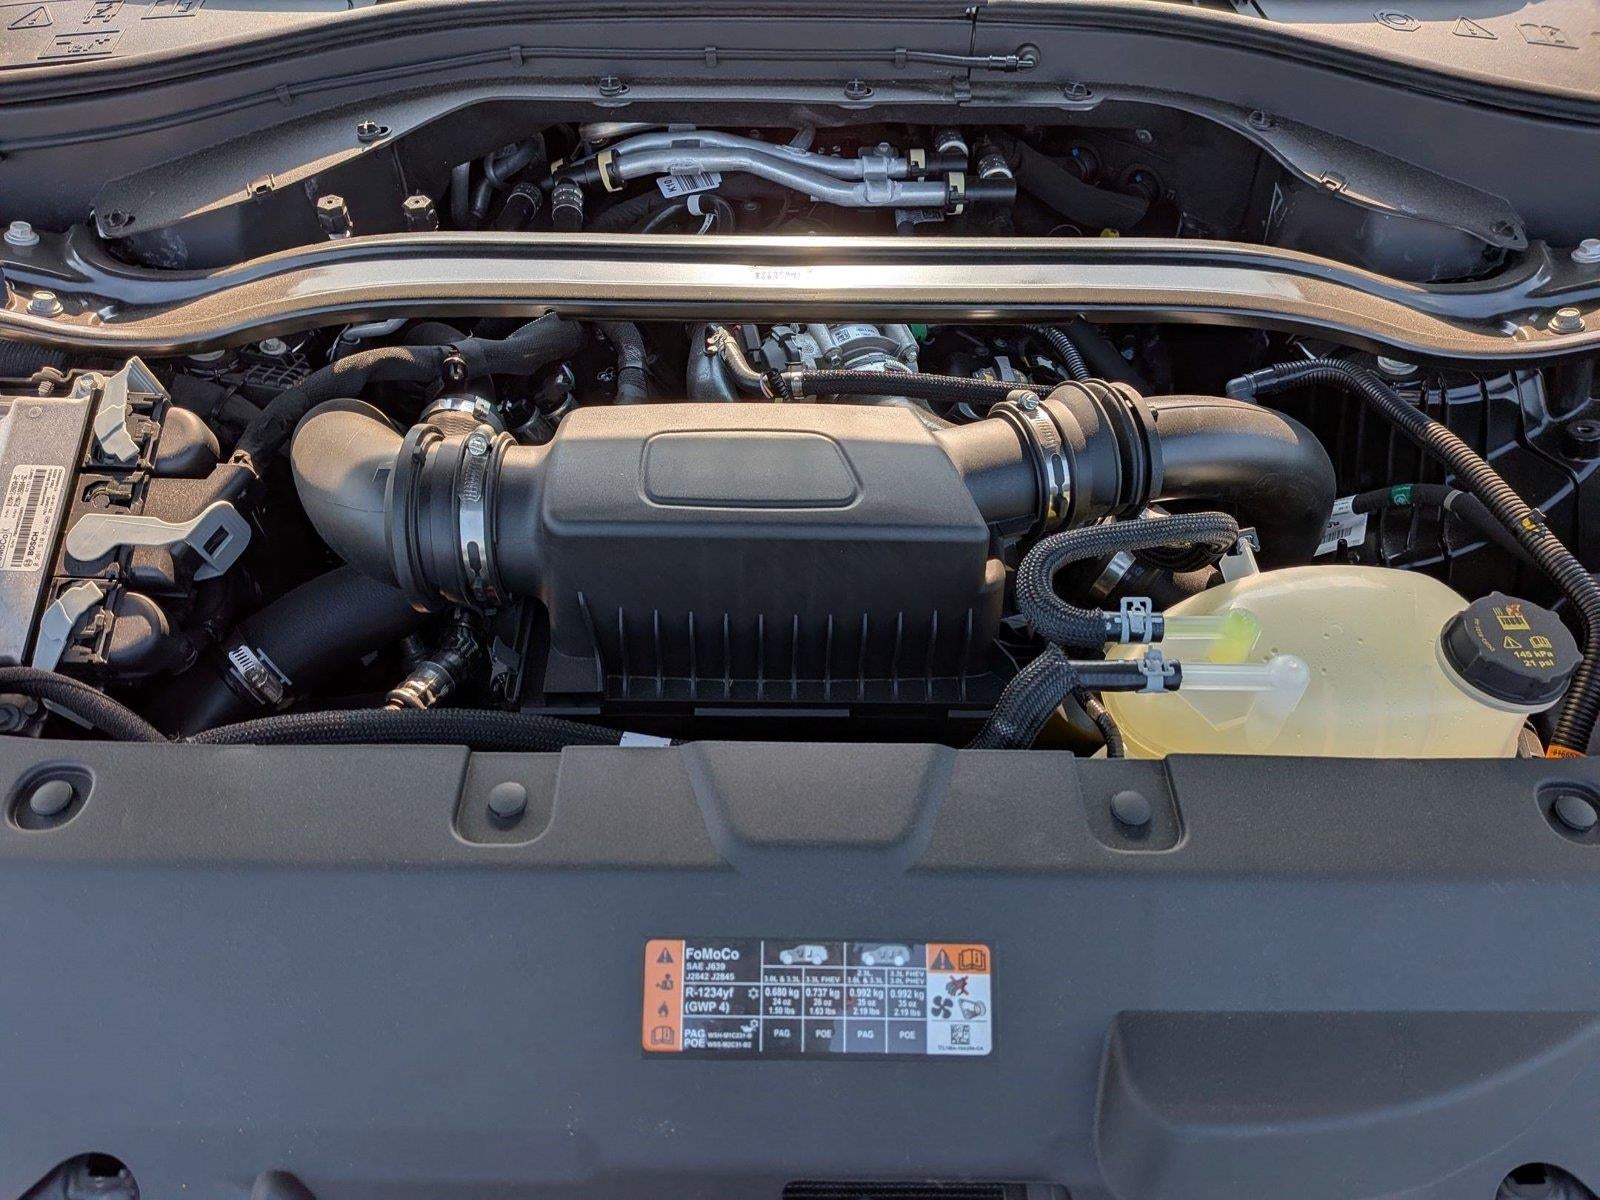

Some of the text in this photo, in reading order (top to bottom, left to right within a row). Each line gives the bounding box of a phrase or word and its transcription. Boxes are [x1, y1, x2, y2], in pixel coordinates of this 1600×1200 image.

[27, 531, 40, 556] BOSCH
[1538, 659, 1555, 669] psi
[685, 947, 740, 960] FoMoCo
[685, 986, 735, 1000] R-1234yf
[764, 987, 800, 999] 0.680 kg
[805, 987, 841, 1000] 0.737 kg
[849, 988, 884, 1000] 0.992 kg
[890, 989, 925, 1001] 0.992 kg
[685, 1001, 730, 1014] (GWP 4)
[898, 1000, 908, 1008] 35
[894, 1008, 922, 1017] 2.19 lbs
[684, 1028, 706, 1038] PAG
[773, 1028, 791, 1038] PAG
[815, 1029, 832, 1039] POE
[857, 1029, 874, 1039] PAG
[899, 1030, 916, 1039] POE
[684, 1038, 706, 1048] POE
